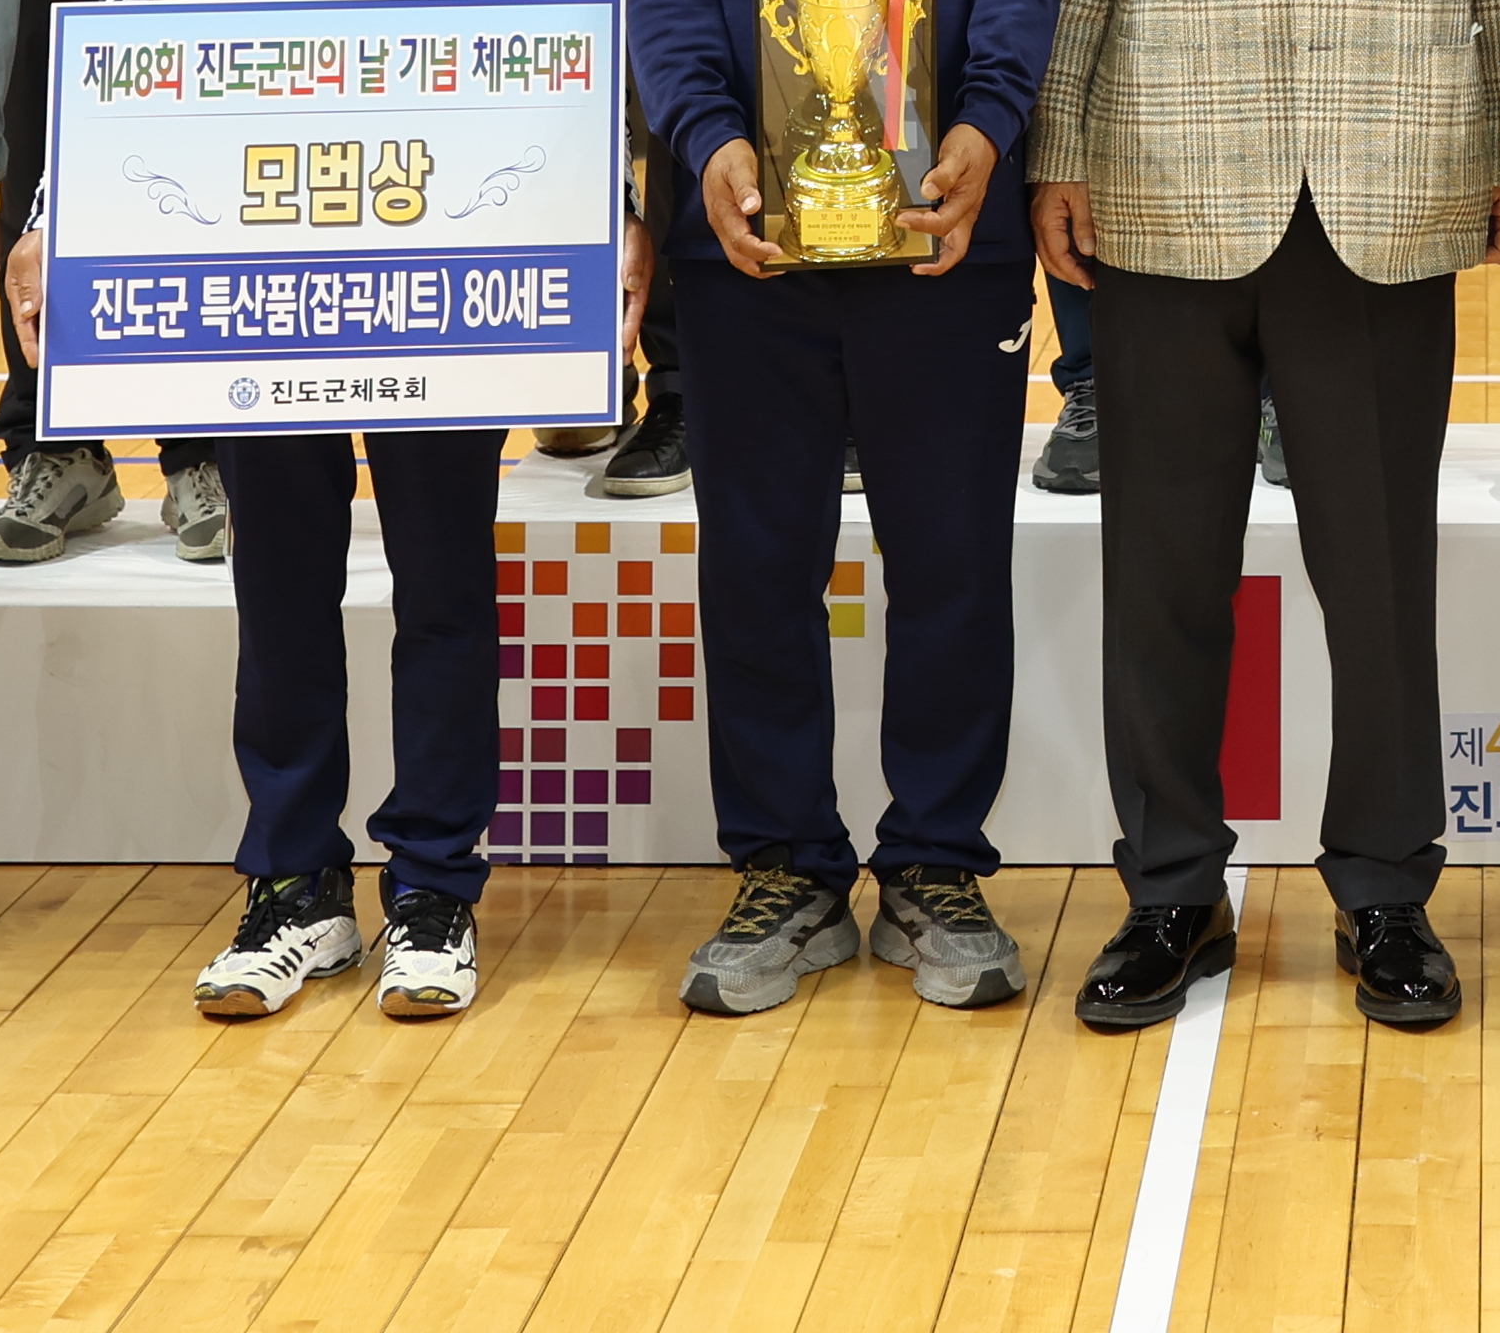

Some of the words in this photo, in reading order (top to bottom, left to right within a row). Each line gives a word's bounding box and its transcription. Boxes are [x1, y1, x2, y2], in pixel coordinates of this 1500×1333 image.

[83, 42, 185, 104] 제48회
[196, 39, 346, 100] 진도군민의
[358, 39, 389, 94] 날
[399, 37, 458, 93] 기념
[471, 33, 592, 92] 체육대회
[239, 140, 433, 226] 모범상
[90, 276, 189, 340] 진도군
[200, 268, 451, 338] 특산품(잡곡세트)
[462, 268, 571, 328] 80세트
[271, 376, 426, 404] 진도군체육회
